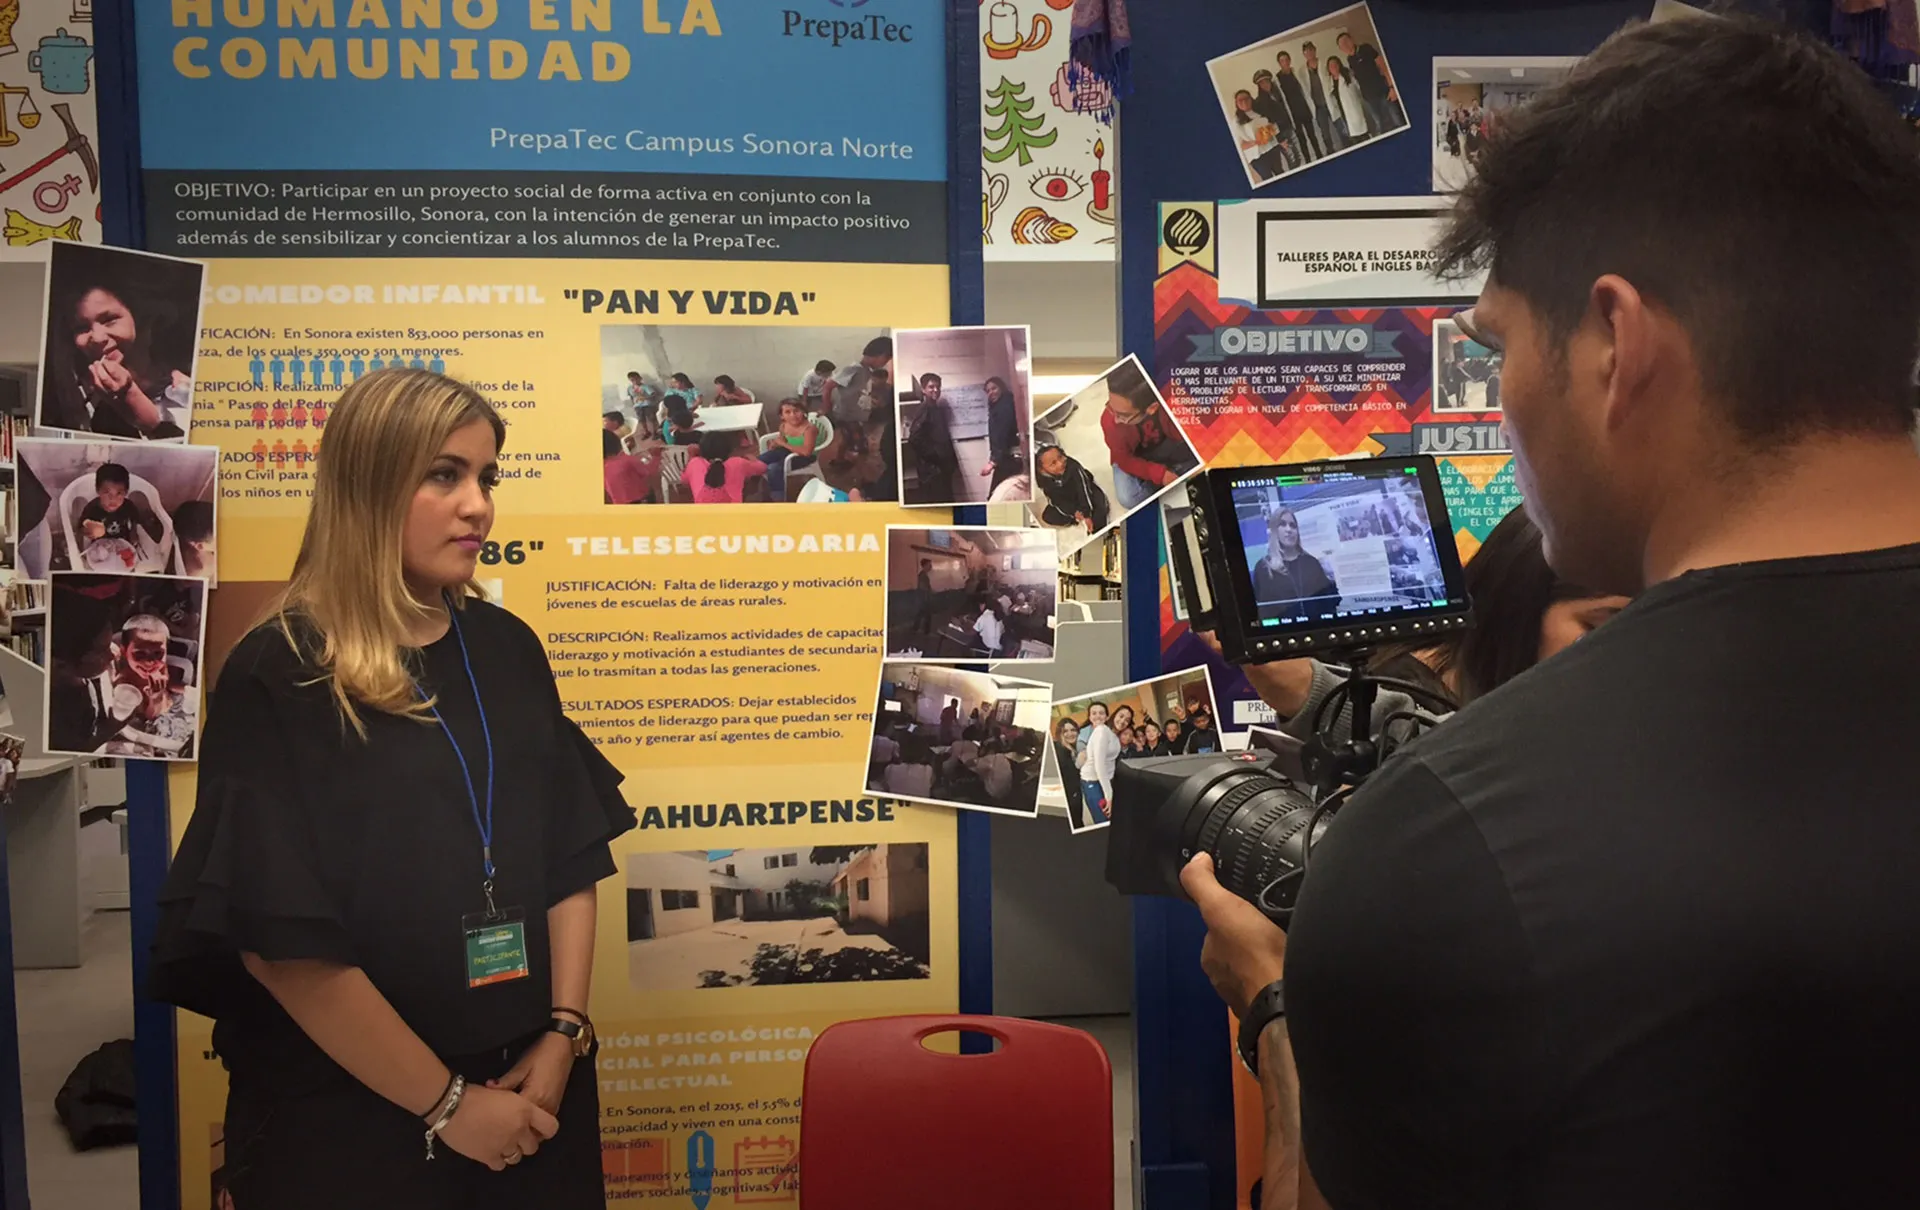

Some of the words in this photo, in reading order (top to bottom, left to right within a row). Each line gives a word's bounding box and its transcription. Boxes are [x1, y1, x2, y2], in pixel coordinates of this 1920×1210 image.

[172, 0, 498, 30] HUMANO
[529, 0, 612, 32] EN
[641, 0, 722, 36] LA
[782, 10, 912, 47] PrepaTec
[172, 36, 632, 83] COMUNIDAD
[490, 127, 617, 153] PrepaTec
[625, 130, 734, 156] Campus
[743, 133, 834, 156] Sonora
[842, 137, 913, 159] Norte
[174, 182, 275, 200] OBJETIVO:
[282, 183, 368, 200] Participar
[374, 186, 395, 197] en
[402, 187, 423, 197] un
[430, 185, 508, 200] proyecto
[514, 184, 564, 198] social
[570, 185, 592, 198] de
[598, 185, 650, 199] forma
[656, 186, 707, 200] activa
[712, 190, 733, 201] en
[739, 189, 815, 205] conjunto
[820, 194, 850, 204] con
[857, 191, 871, 205] la
[175, 206, 278, 221] comunidad
[284, 206, 306, 220] de
[312, 206, 415, 222] Hermosillo,
[421, 207, 489, 222] Sonora,
[494, 210, 526, 221] con
[532, 208, 548, 221] la
[553, 208, 636, 222] intención
[642, 210, 663, 223] de
[668, 213, 735, 226] generar
[741, 215, 762, 224] un
[769, 212, 838, 228] impacto
[844, 214, 909, 230] positivo
[177, 230, 248, 244] además
[253, 229, 276, 244] de
[281, 230, 382, 244] sensibilizar
[387, 234, 397, 247] y
[402, 230, 511, 244] concientizar
[517, 234, 527, 244] a
[532, 231, 557, 244] los
[563, 231, 640, 246] alumnos
[645, 232, 667, 246] de
[673, 232, 688, 246] la
[694, 232, 779, 250] PrepaTec.
[1277, 252, 1329, 262] TALLERES
[1332, 251, 1363, 262] PARA
[1367, 251, 1379, 260] EL
[1383, 250, 1438, 260] DESARRO
[1305, 259, 1357, 273] ESPAÑOL
[1361, 262, 1367, 271] E
[1371, 262, 1412, 271] INGLES
[382, 284, 545, 304] INFANTIL
[563, 289, 659, 314] "PAN
[667, 289, 694, 314] Y
[702, 290, 815, 315] VIDA"
[283, 327, 300, 338] En
[304, 327, 352, 338] Sonora
[355, 327, 403, 338] existen
[407, 327, 459, 340] 853,000
[462, 330, 523, 340] personas
[527, 330, 544, 338] en
[1220, 327, 1368, 355] OBJETIVO
[1171, 367, 1200, 376] LOGRAR
[1204, 367, 1219, 375] QUE
[1223, 367, 1238, 375] LOS
[1243, 366, 1276, 374] ALUMNOS
[1281, 365, 1300, 374] SEAN
[1305, 365, 1339, 373] CAPACES
[1343, 364, 1353, 372] DE
[1358, 363, 1406, 372] COMPRENDER
[1171, 378, 1180, 386] LO
[1185, 377, 1200, 385] MAS
[1204, 376, 1248, 385] RELEVANTE
[1252, 376, 1262, 384] DE
[1266, 376, 1276, 384] UN
[1281, 375, 1310, 385] TEXTO,
[1314, 375, 1319, 383] A
[1324, 375, 1334, 383] SU
[1338, 374, 1353, 382] VEZ
[1357, 373, 1401, 382] MINIMIZAR
[1171, 387, 1185, 395] LOS
[1190, 386, 1233, 395] PROBLEMAS
[1238, 386, 1248, 394] DE
[1252, 385, 1286, 394] LECTURA
[1296, 385, 1301, 393] Y
[1305, 383, 1373, 393] TRANSFORMARLOS
[1377, 383, 1387, 391] EN
[1171, 397, 1234, 405] HERRAMIENTAS.
[245, 470, 275, 480] Civil
[278, 472, 309, 482] para
[245, 488, 282, 498] niños
[566, 533, 880, 555] TELESECUNDARIA
[546, 579, 655, 594] JUSTIFICACIÓN:
[664, 579, 696, 590] Falta
[699, 579, 716, 589] de
[719, 578, 778, 591] liderazgo
[781, 581, 789, 591] y
[792, 576, 863, 587] motivación
[546, 598, 597, 611] jóvenes
[600, 597, 617, 608] de
[620, 596, 676, 608] escuelas
[680, 596, 696, 607] de
[700, 596, 735, 606] áreas
[738, 595, 786, 606] rurales.
[548, 630, 648, 643] DESCRIPCIÓN:
[653, 630, 727, 641] Realizamos
[730, 628, 803, 639] actividades
[806, 628, 823, 638] de
[577, 666, 590, 677] lo
[660, 667, 667, 675] a
[671, 664, 707, 675] todas
[711, 663, 728, 674] las
[732, 662, 820, 676] generaciones.
[648, 697, 734, 709] ESPERADOS:
[738, 696, 773, 709] Dejar
[776, 694, 856, 706] establecidos
[1248, 702, 1272, 713] PRE
[607, 734, 632, 744] año
[635, 736, 642, 745] y
[645, 734, 695, 746] generar
[698, 731, 717, 741] así
[720, 731, 770, 743] agentes
[773, 729, 789, 739] de
[792, 728, 843, 739] cambio.
[660, 1052, 722, 1067] PARA
[729, 1048, 800, 1063] PERSO
[603, 1074, 732, 1092] TELECTUAL
[606, 1107, 623, 1117] En
[626, 1105, 675, 1116] Sonora,
[679, 1104, 695, 1112] en
[698, 1101, 709, 1112] el
[714, 1102, 744, 1112] 2015,
[747, 1099, 758, 1109] el
[762, 1098, 790, 1111] 5.5%
[671, 1122, 678, 1132] y
[681, 1118, 715, 1132] viven
[718, 1119, 734, 1127] en
[738, 1118, 762, 1126] una
[765, 1115, 799, 1125] const
